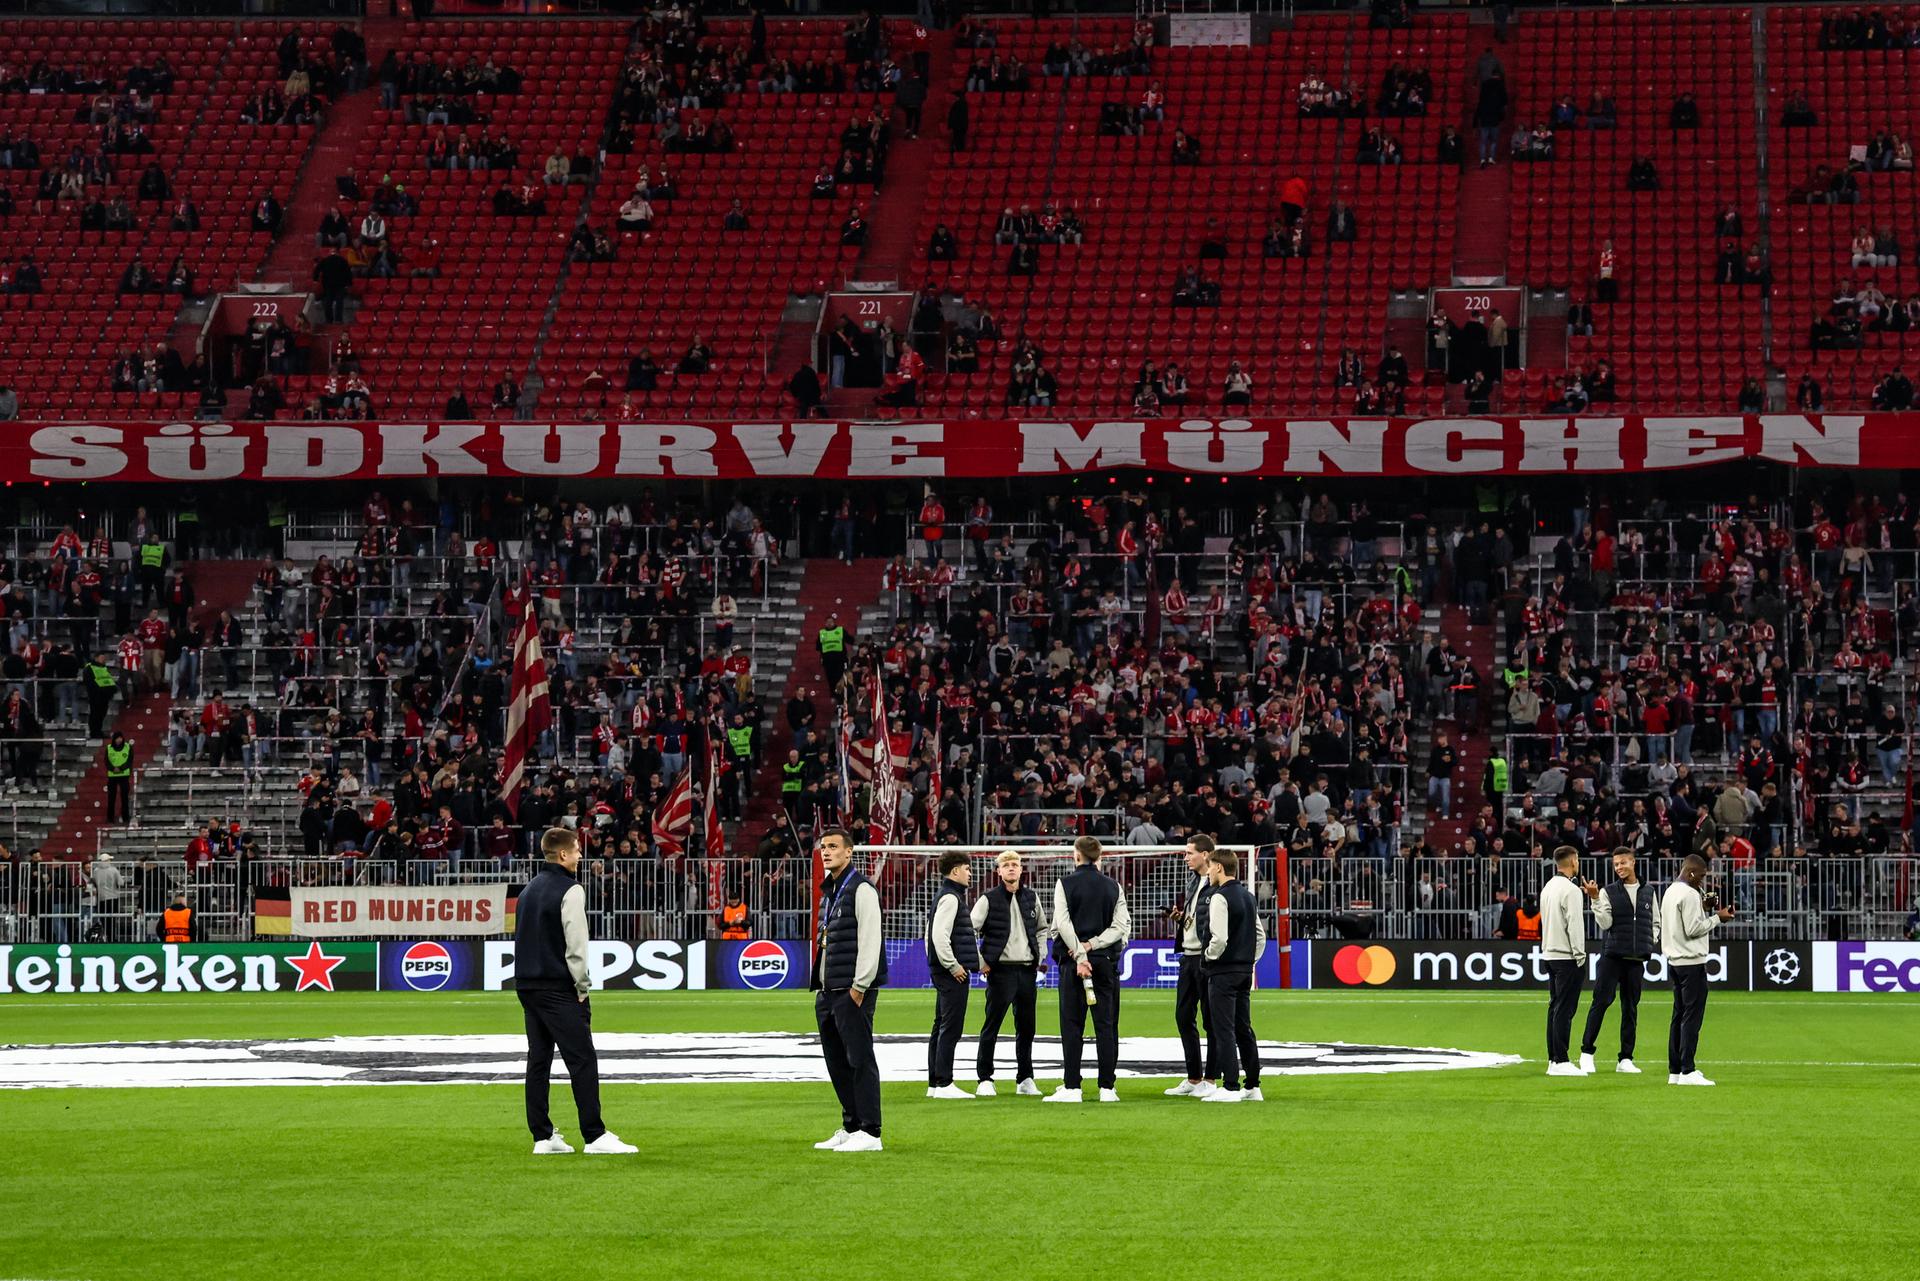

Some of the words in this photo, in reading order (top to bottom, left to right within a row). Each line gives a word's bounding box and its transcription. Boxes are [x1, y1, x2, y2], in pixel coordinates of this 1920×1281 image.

[252, 302, 278, 317] 222
[859, 301, 881, 314] 221
[1464, 296, 1491, 310] 220
[30, 422, 945, 480] SÜDKURVE
[1018, 415, 1865, 473] MÜNCHEN
[1821, 530, 1829, 542] 9
[303, 900, 357, 923] RED
[405, 961, 449, 971] PEPSI
[484, 940, 706, 991] PPSI
[741, 960, 785, 970] PEPSI
[1413, 946, 1727, 982] mastrad
